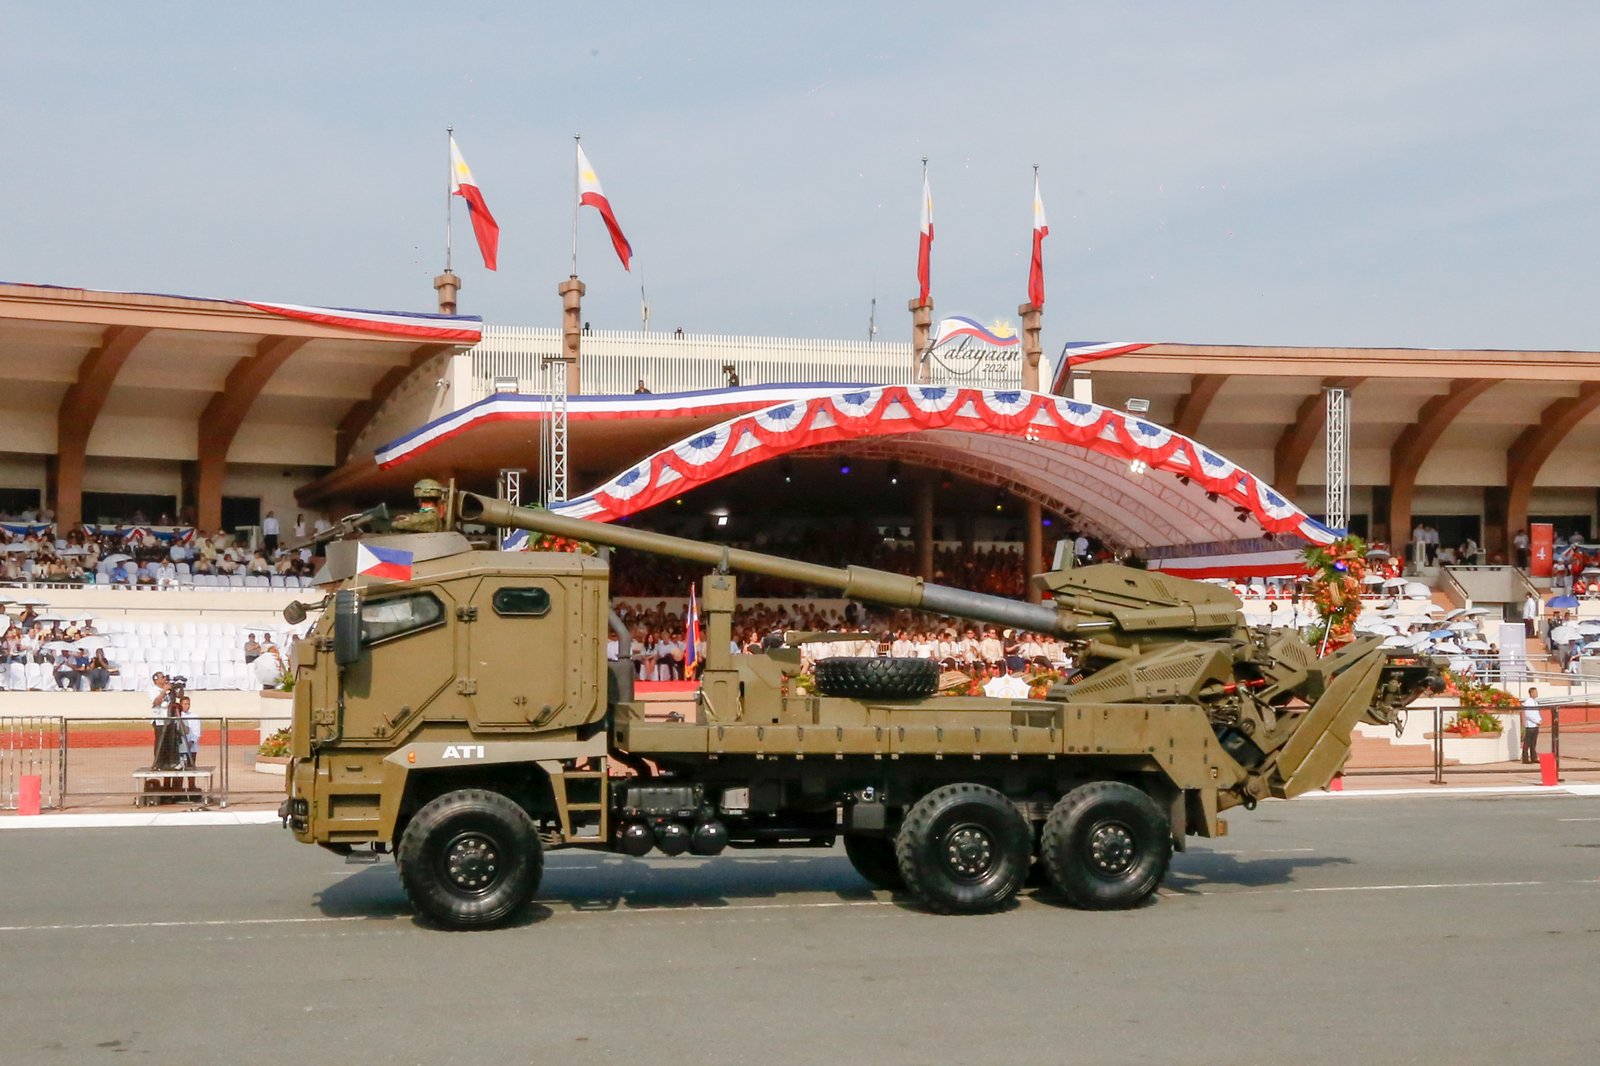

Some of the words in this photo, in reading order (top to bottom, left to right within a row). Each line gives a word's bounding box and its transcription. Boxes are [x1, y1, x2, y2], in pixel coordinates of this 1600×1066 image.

[919, 334, 1021, 375] Kalayaan
[982, 364, 1008, 373] 2026
[1536, 546, 1546, 560] 4
[442, 745, 485, 759] ATI
